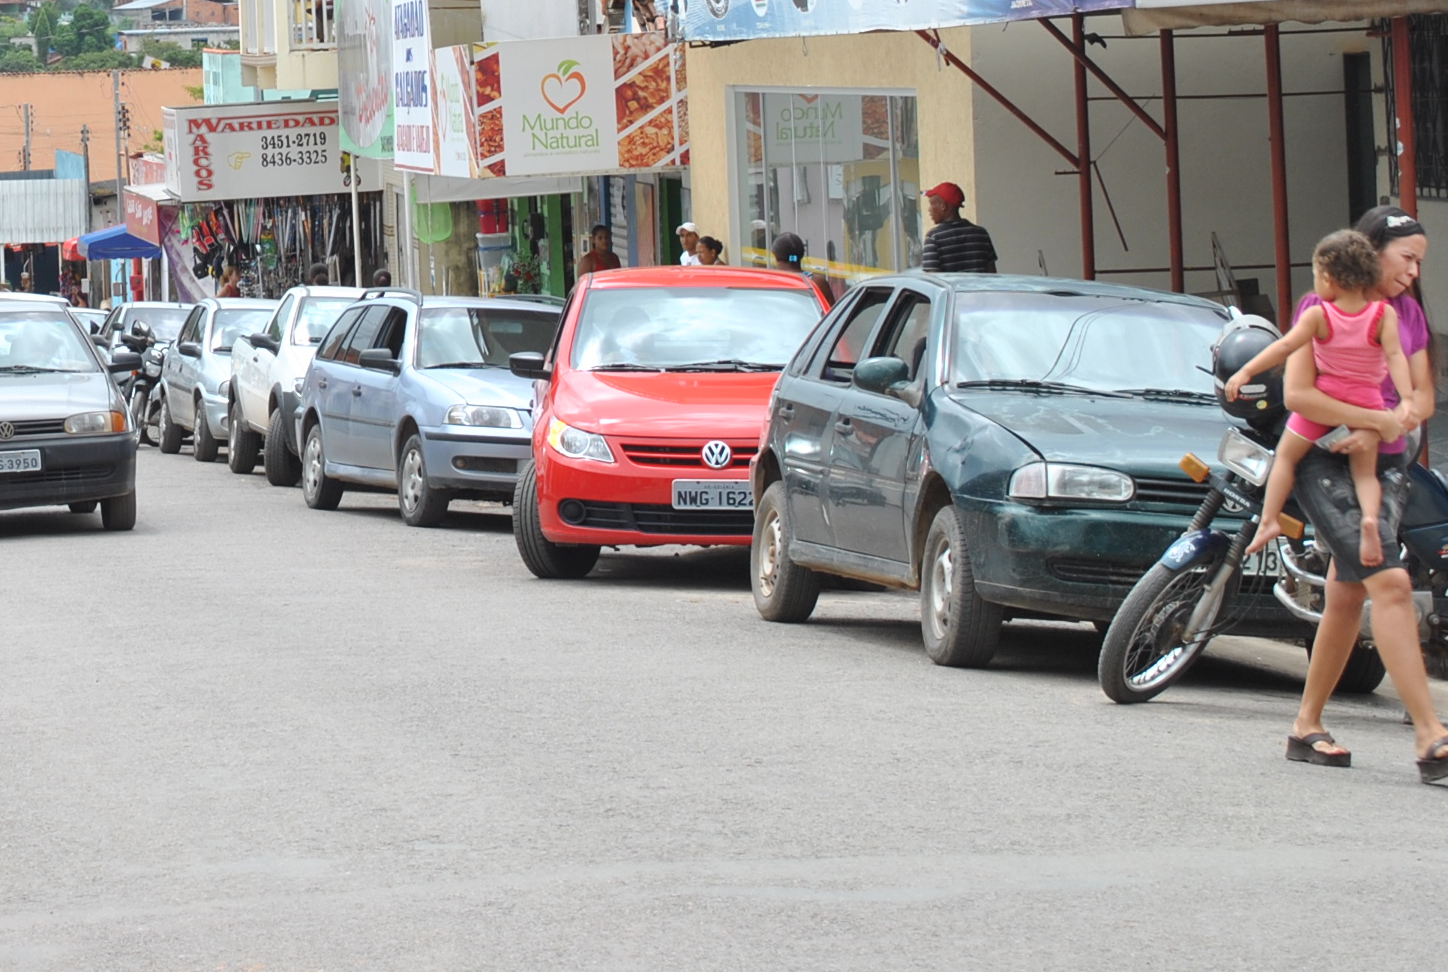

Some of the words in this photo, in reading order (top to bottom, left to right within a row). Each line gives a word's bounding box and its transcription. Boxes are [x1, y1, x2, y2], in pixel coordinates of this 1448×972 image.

[521, 111, 593, 133] Mundo
[261, 131, 327, 150] 3451-2719
[531, 128, 599, 150] Natural
[261, 149, 328, 168] 8436-3325
[1223, 487, 1251, 508] HONDA
